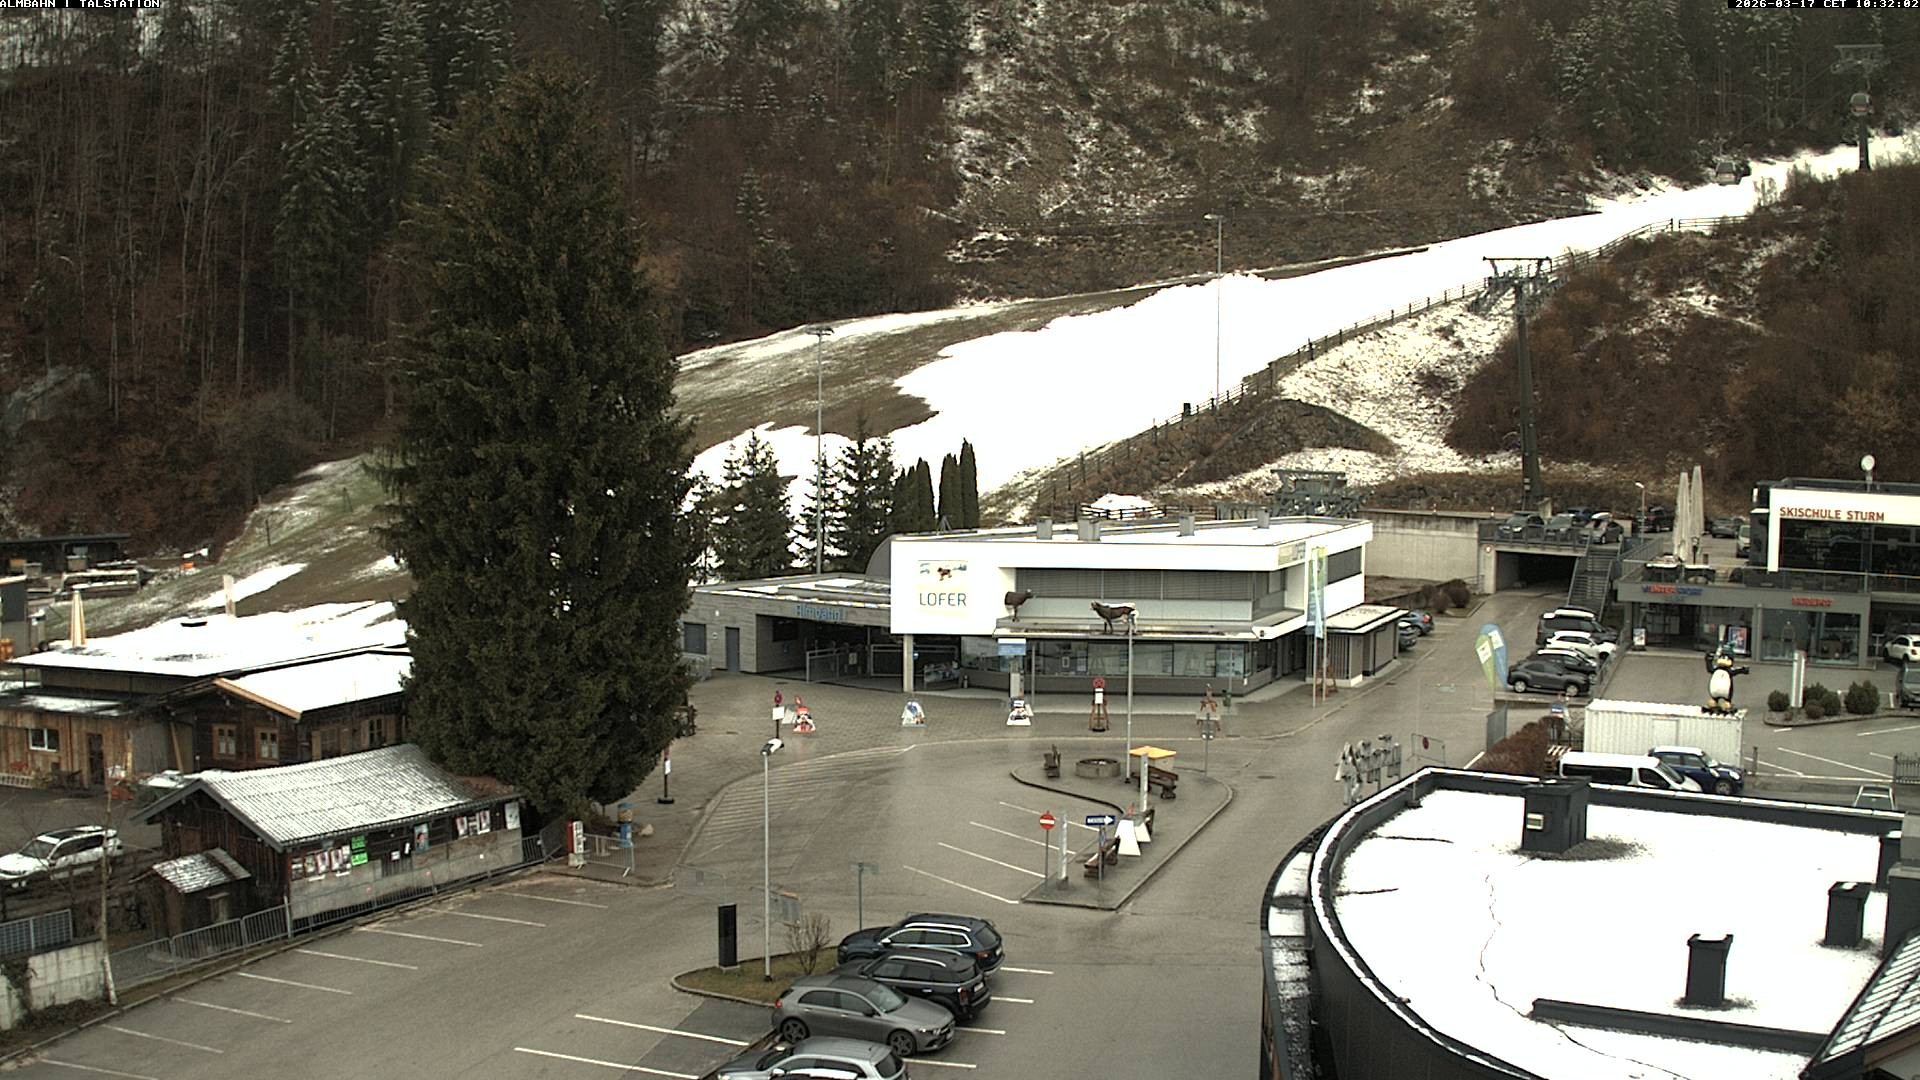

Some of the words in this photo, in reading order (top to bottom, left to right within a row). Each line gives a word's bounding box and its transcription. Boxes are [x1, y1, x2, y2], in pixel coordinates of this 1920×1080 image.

[1779, 507, 1842, 520] SKISCHULE
[1846, 510, 1885, 521] STURM
[919, 592, 967, 607] LOFER
